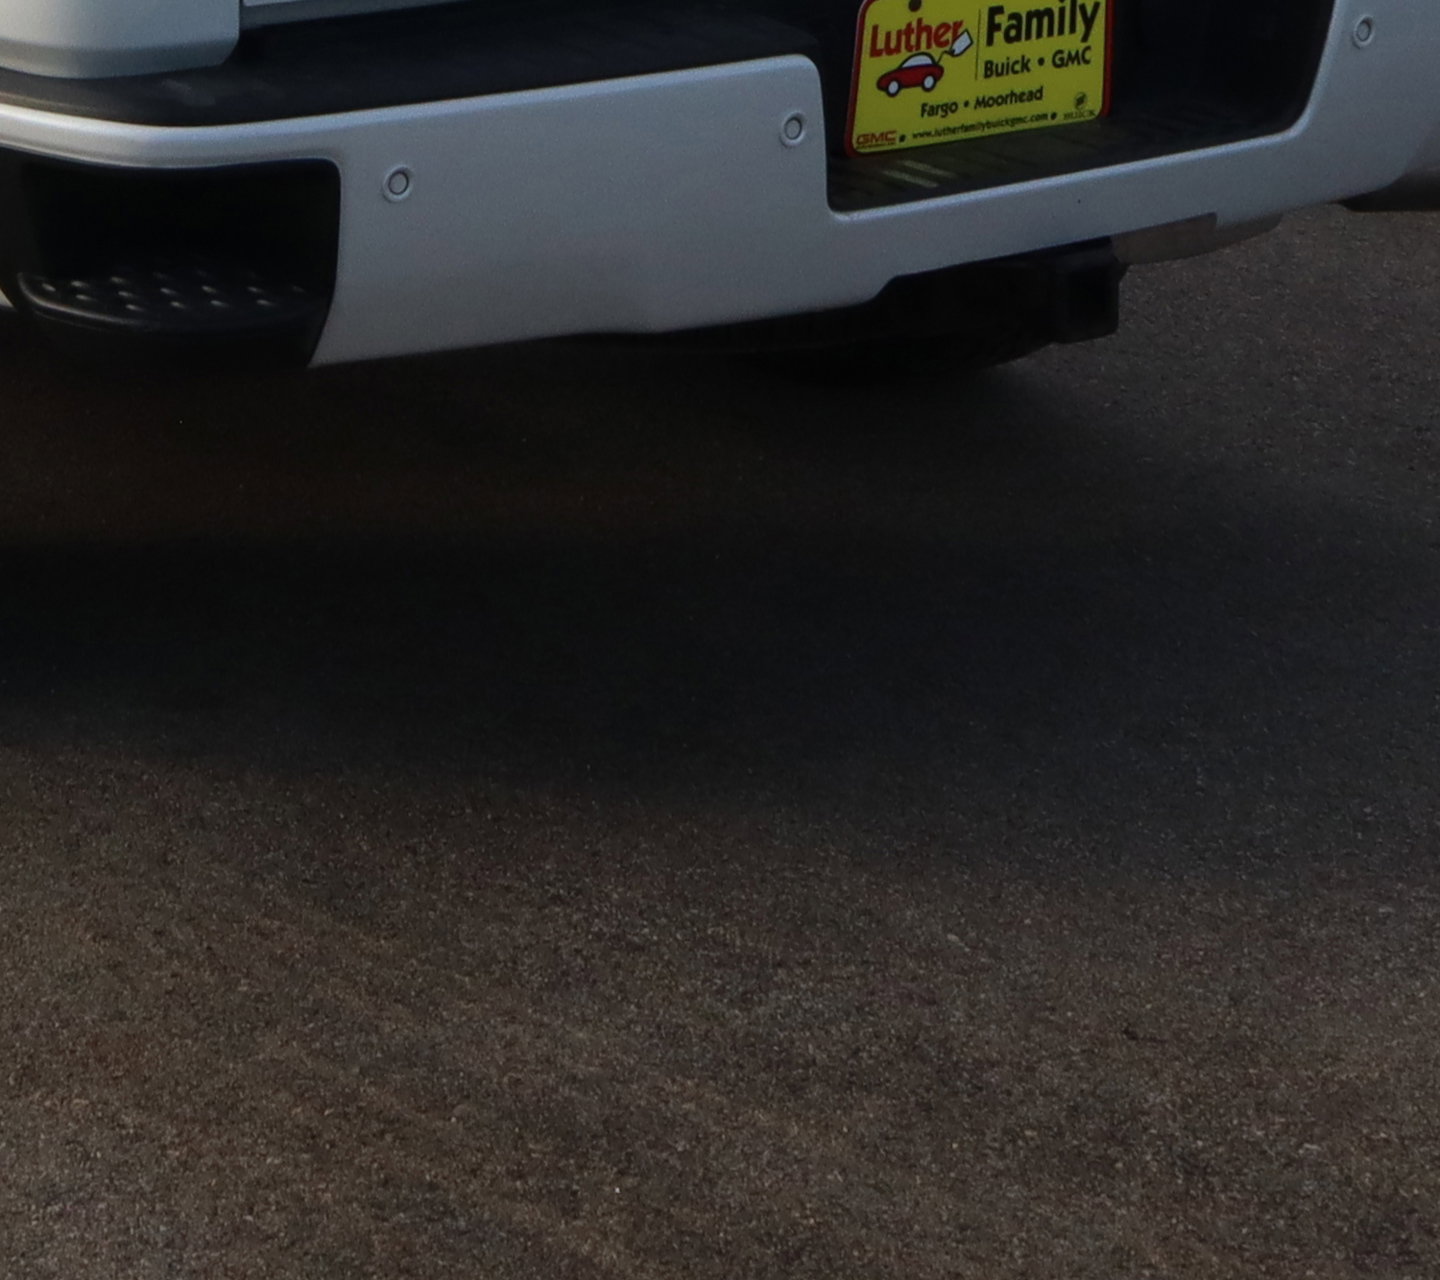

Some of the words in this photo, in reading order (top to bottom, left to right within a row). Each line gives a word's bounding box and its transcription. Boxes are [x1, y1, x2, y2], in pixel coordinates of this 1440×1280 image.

[869, 17, 964, 59] Luther
[983, 55, 1032, 80] Buick
[1051, 45, 1092, 69] GMC
[920, 102, 959, 118] Fargo
[973, 86, 1044, 111] Moorhead
[856, 130, 897, 145] GMC
